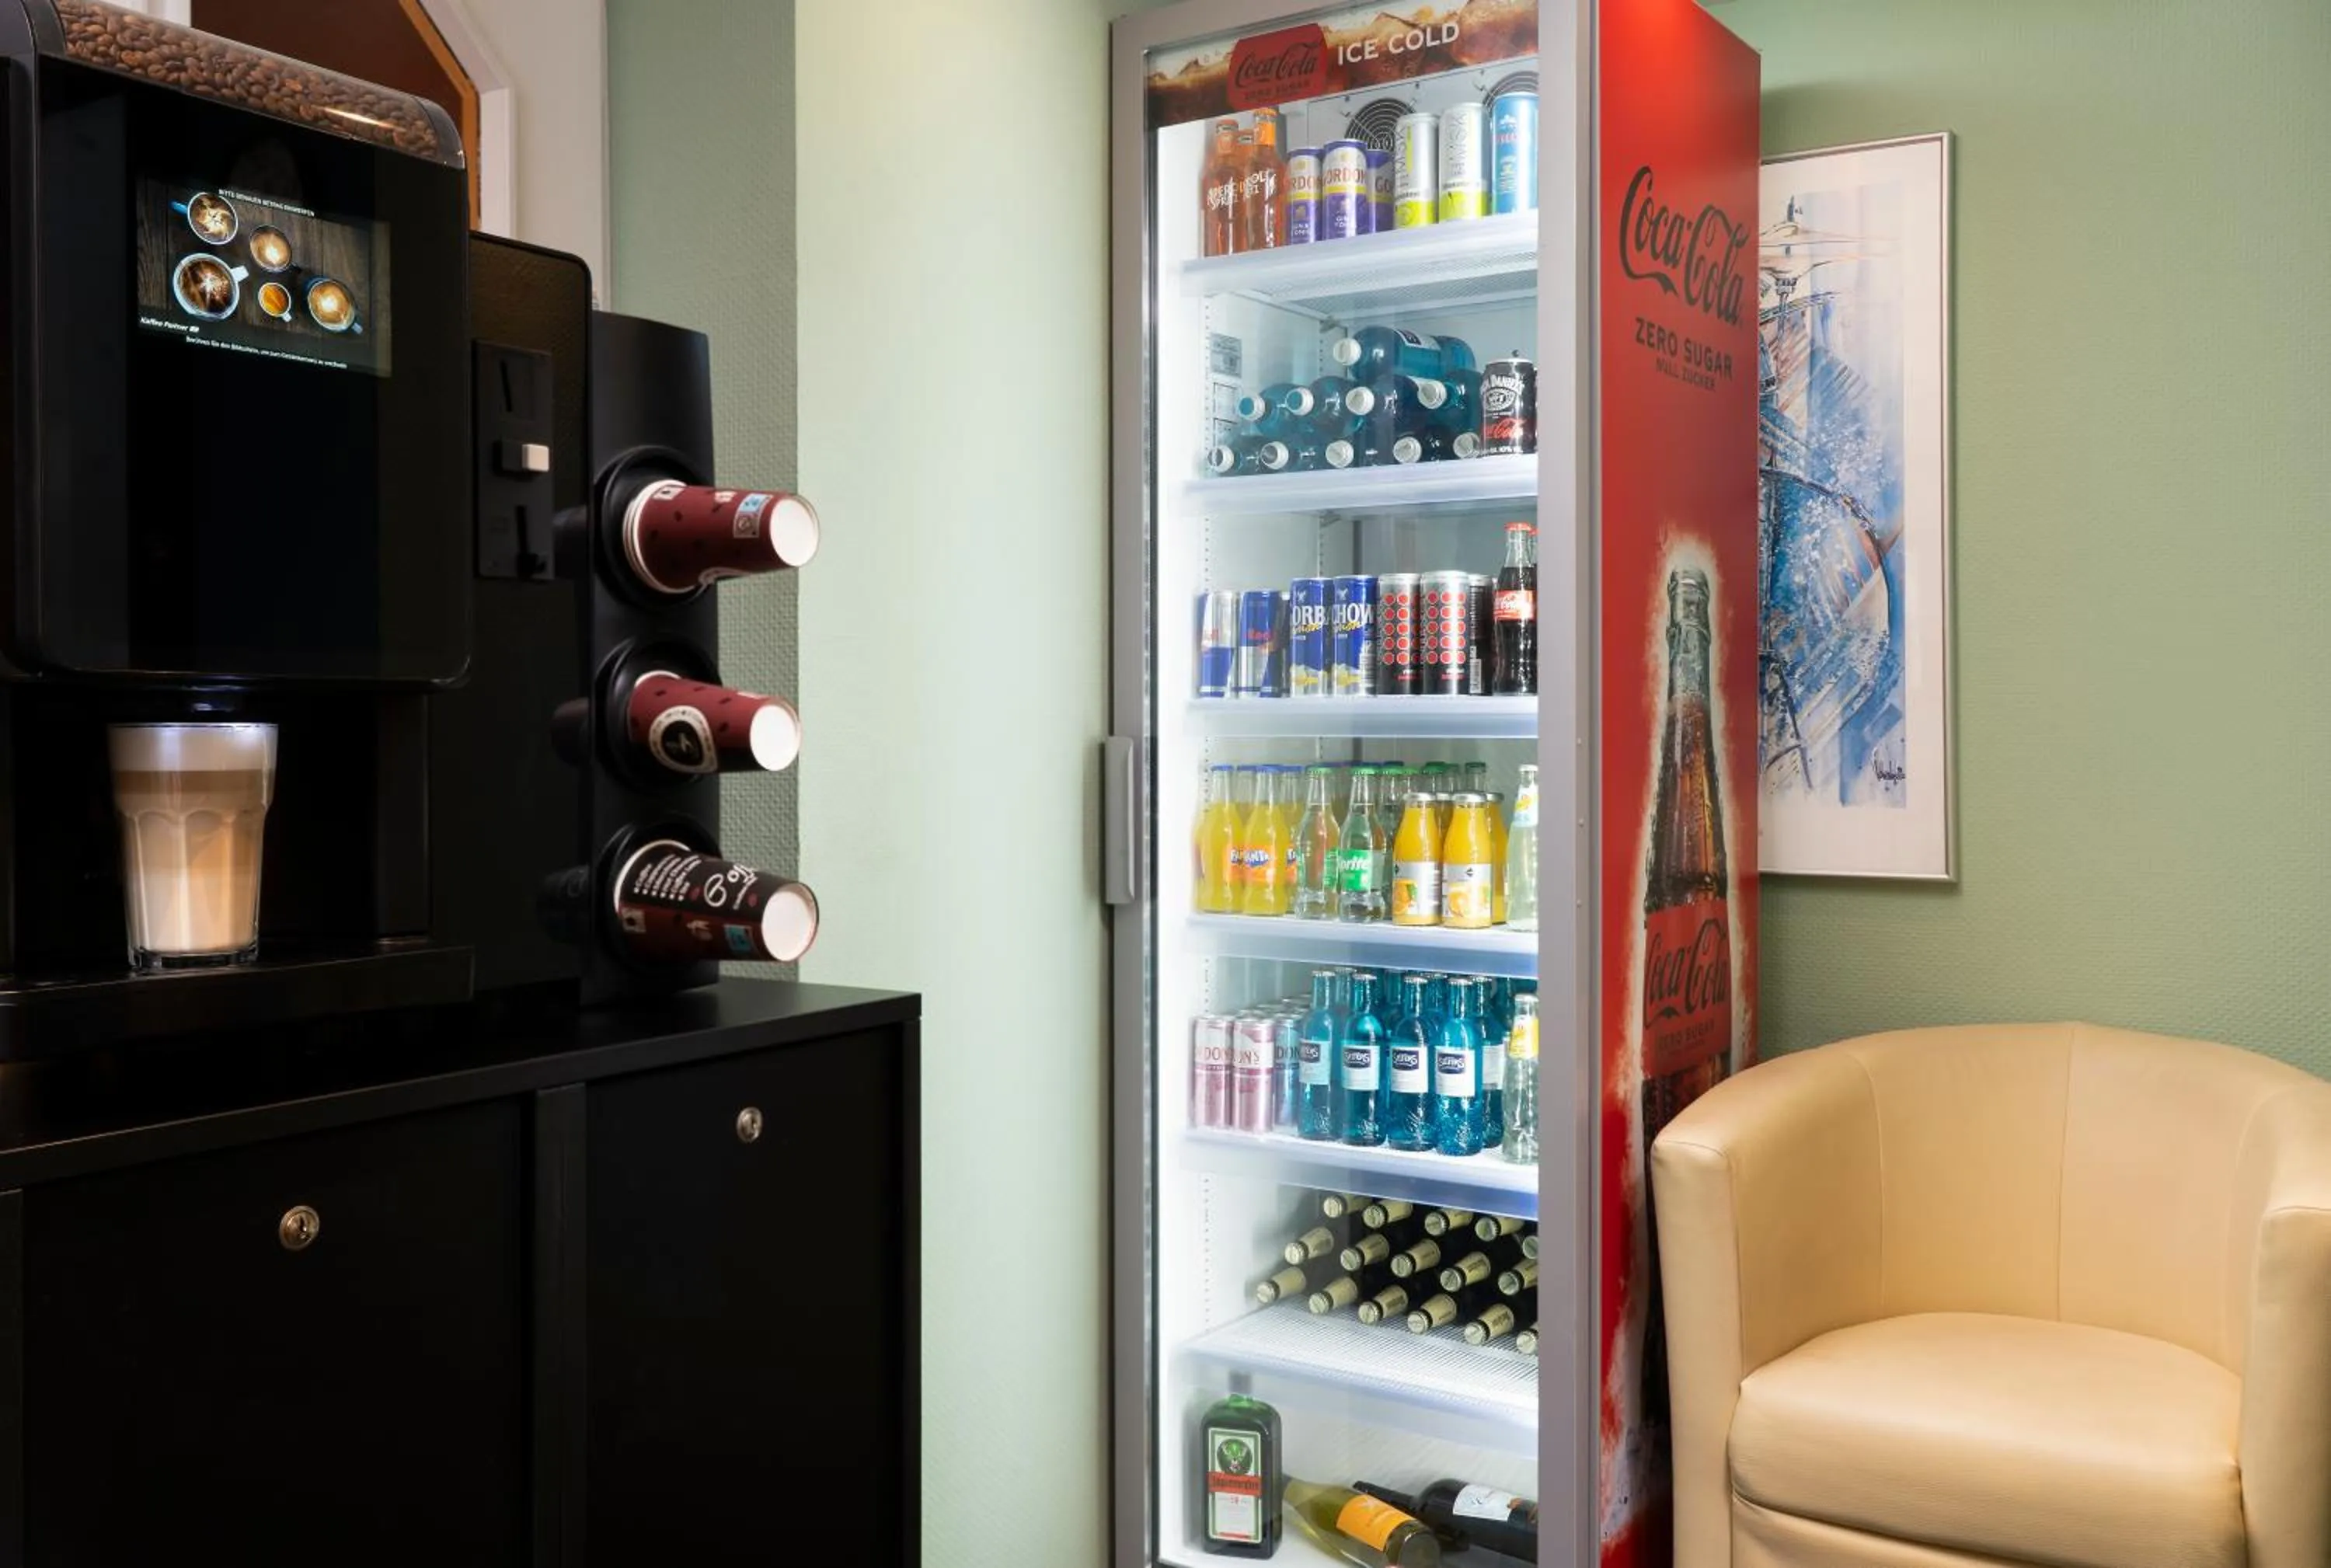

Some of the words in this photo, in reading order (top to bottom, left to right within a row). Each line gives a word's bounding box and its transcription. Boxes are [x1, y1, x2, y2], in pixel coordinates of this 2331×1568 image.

[1235, 42, 1319, 88] Coca-Cola
[1337, 38, 1379, 66] ICE
[1388, 21, 1460, 54] COLD
[1619, 165, 1750, 326] Coca-Cola
[1635, 316, 1678, 357] ZERO
[1683, 337, 1733, 382] SUGAR
[1643, 918, 1728, 1030] Coca-Cola
